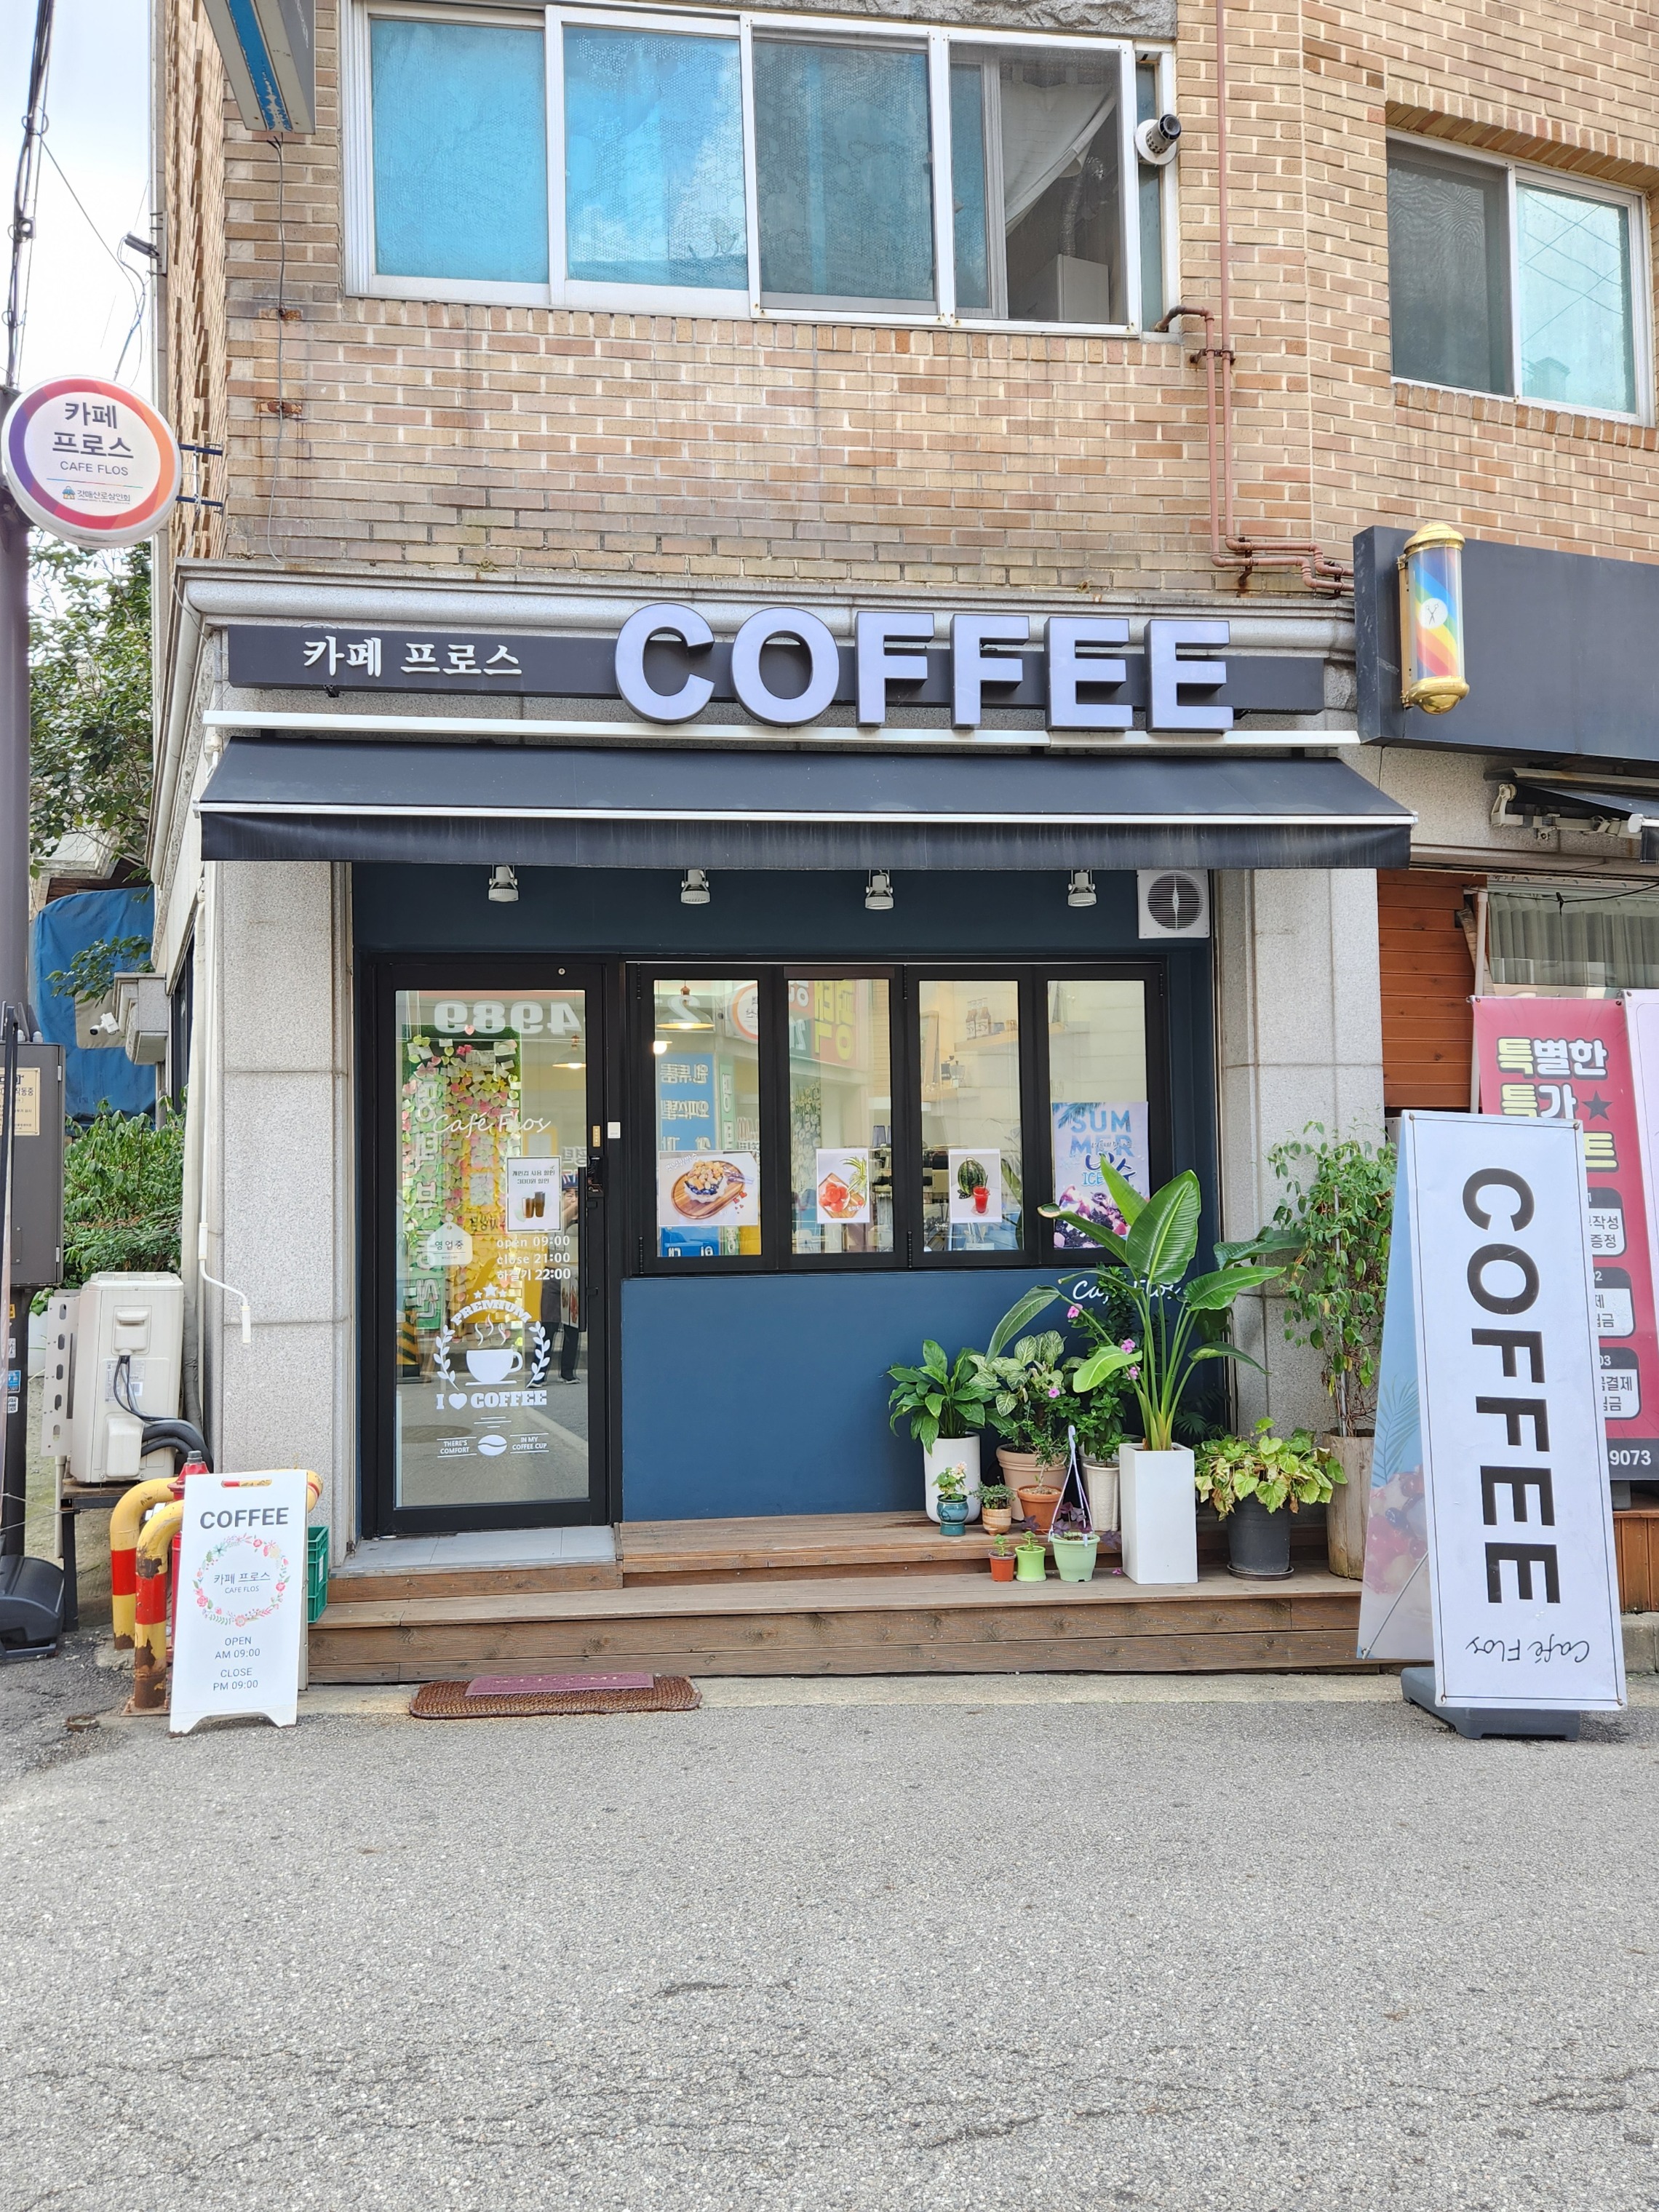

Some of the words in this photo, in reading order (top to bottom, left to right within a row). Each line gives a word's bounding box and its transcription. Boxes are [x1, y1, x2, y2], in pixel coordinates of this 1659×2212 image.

[65, 402, 118, 429] 카페
[52, 431, 134, 459] 프로스
[60, 461, 93, 473] CAFE
[98, 464, 129, 476] FLOS
[303, 636, 382, 678] 카페
[400, 643, 522, 677] 프로스
[616, 602, 1234, 735] COFFEE
[1497, 1037, 1609, 1080] 특별한
[1501, 1083, 1578, 1119] 특가
[1071, 1110, 1131, 1133] SUM
[1082, 1171, 1105, 1185] ICE
[1588, 1215, 1619, 1230] 작성
[434, 1240, 464, 1251] 영업중
[496, 1238, 528, 1249] open
[533, 1236, 570, 1246] 09:00
[1590, 1234, 1617, 1249] 증정
[496, 1254, 530, 1265] close
[534, 1252, 570, 1263] 21:00
[535, 1268, 571, 1280] 22:00
[1594, 1270, 1603, 1281] 2
[450, 1300, 532, 1326] PREMIUM
[1461, 1168, 1561, 1604] COFFEE
[1602, 1376, 1633, 1392] 결제
[437, 1393, 444, 1409] I
[470, 1391, 546, 1408] COFFEE
[199, 1507, 289, 1529] COFFEE
[214, 1572, 235, 1585] 카페
[238, 1572, 271, 1582] 프로스
[224, 1637, 252, 1646] OPEN
[215, 1652, 231, 1660] AM
[234, 1648, 260, 1658] 09:00
[220, 1668, 252, 1677] CLOSE
[213, 1682, 229, 1691] PM
[231, 1679, 258, 1690] 09:00
